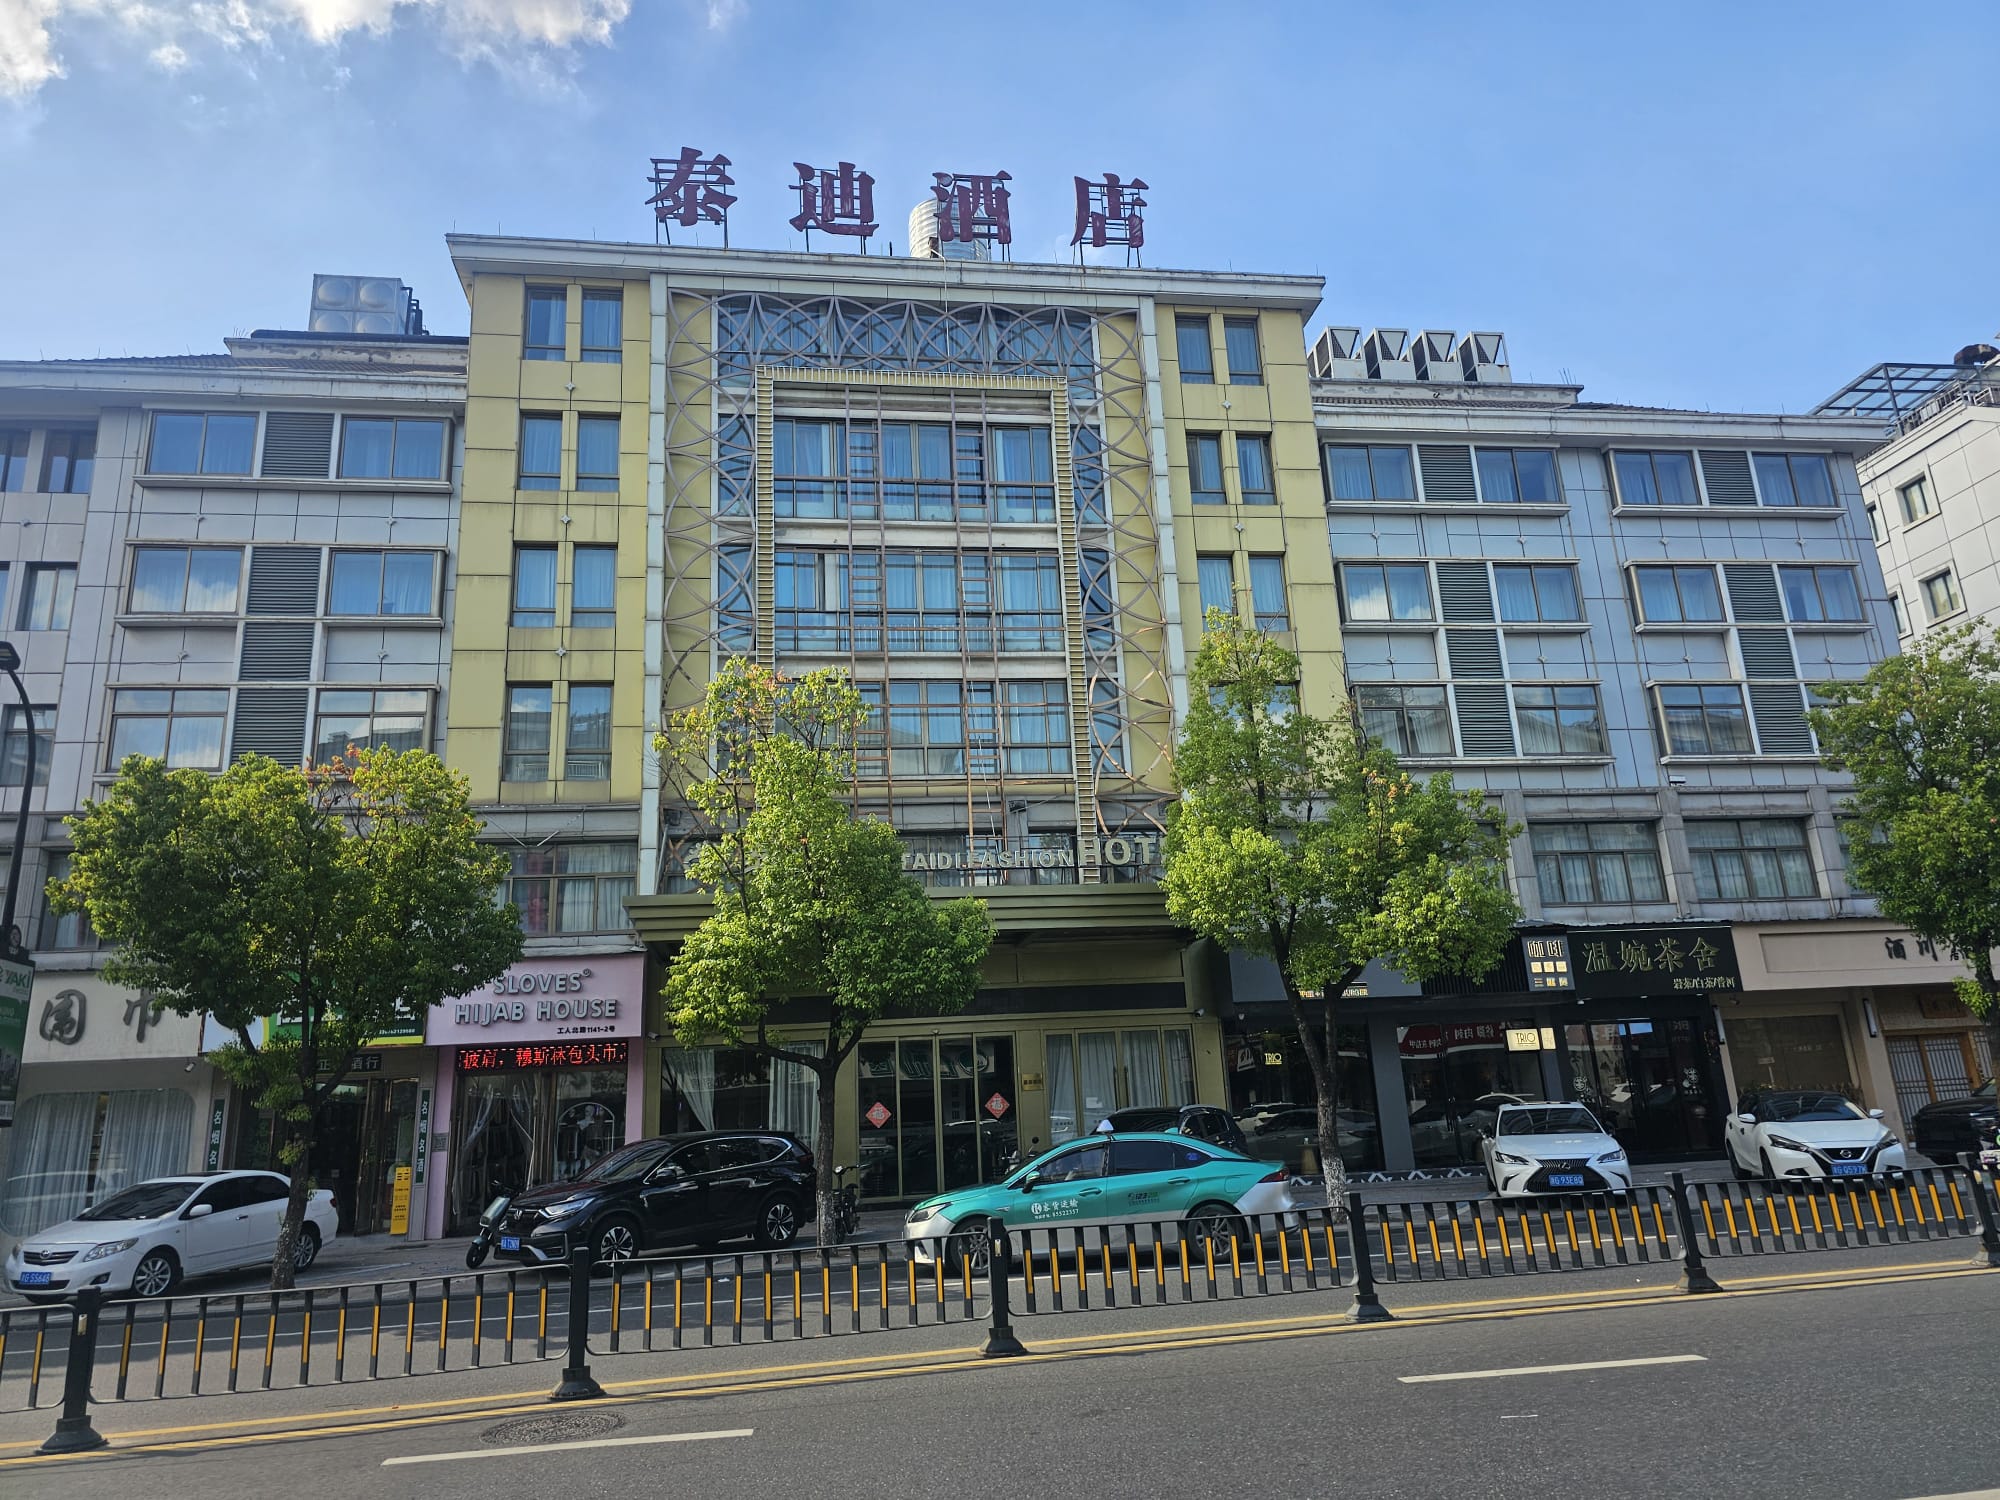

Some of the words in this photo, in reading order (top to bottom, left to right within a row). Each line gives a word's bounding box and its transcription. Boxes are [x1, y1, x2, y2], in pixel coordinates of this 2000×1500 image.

[645, 146, 1149, 249] 泰迪酒店
[968, 850, 1075, 868] FASHION
[493, 971, 582, 995] SLOVES
[454, 1001, 525, 1026] HIJAB
[537, 998, 618, 1021] HOUSE
[1516, 1032, 1536, 1042] TRIO
